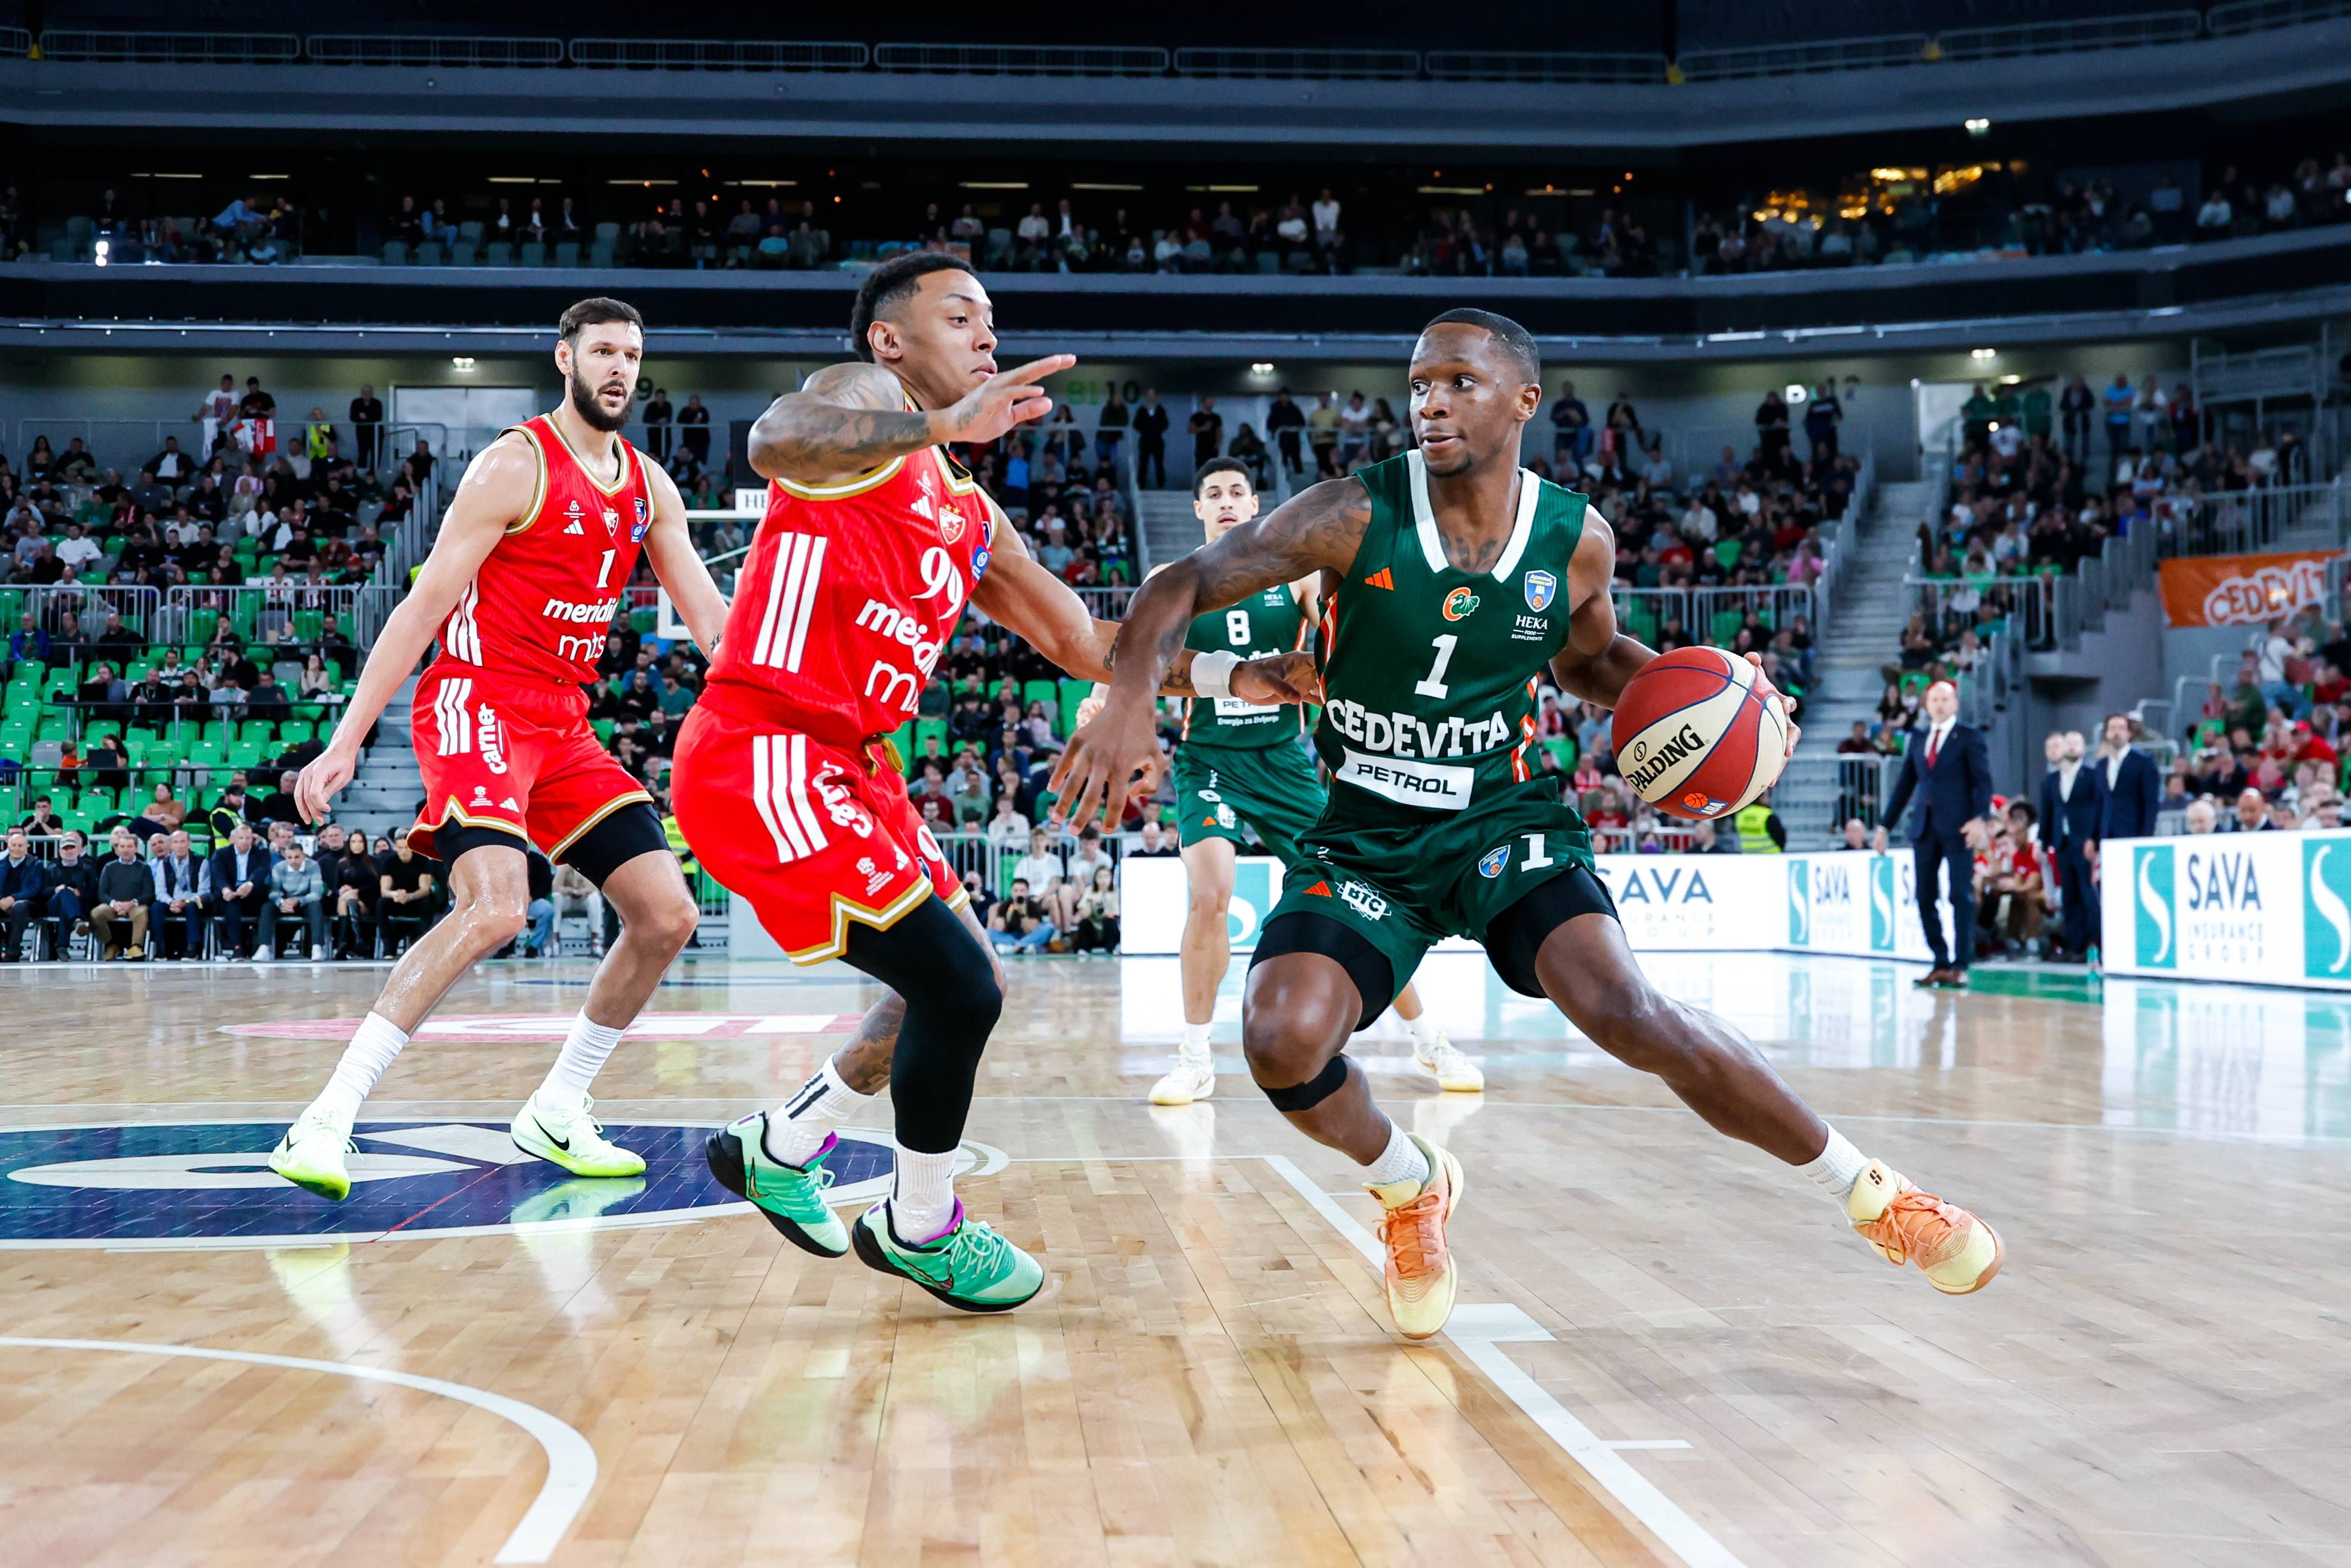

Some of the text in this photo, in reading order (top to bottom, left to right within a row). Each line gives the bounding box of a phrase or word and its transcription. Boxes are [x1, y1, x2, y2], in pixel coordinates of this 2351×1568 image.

[596, 549, 616, 588] 1
[2210, 568, 2326, 621] CEDEVIT
[1226, 610, 1251, 646] 8
[1515, 614, 1548, 630] HEKA
[557, 631, 607, 662] mts
[1414, 634, 1458, 700] 1
[1326, 699, 1510, 759] CEDEVITA
[1625, 723, 1706, 794] PALDING
[1356, 763, 1457, 796] PETROL
[1521, 833, 1554, 872] 1
[1348, 887, 1382, 912] BTC
[1814, 864, 1850, 905] SAVA
[2187, 852, 2262, 911] SAVA
[1628, 912, 1714, 922] URANCE
[1646, 927, 1715, 937] OUP
[2188, 922, 2264, 942] INSURANCE
